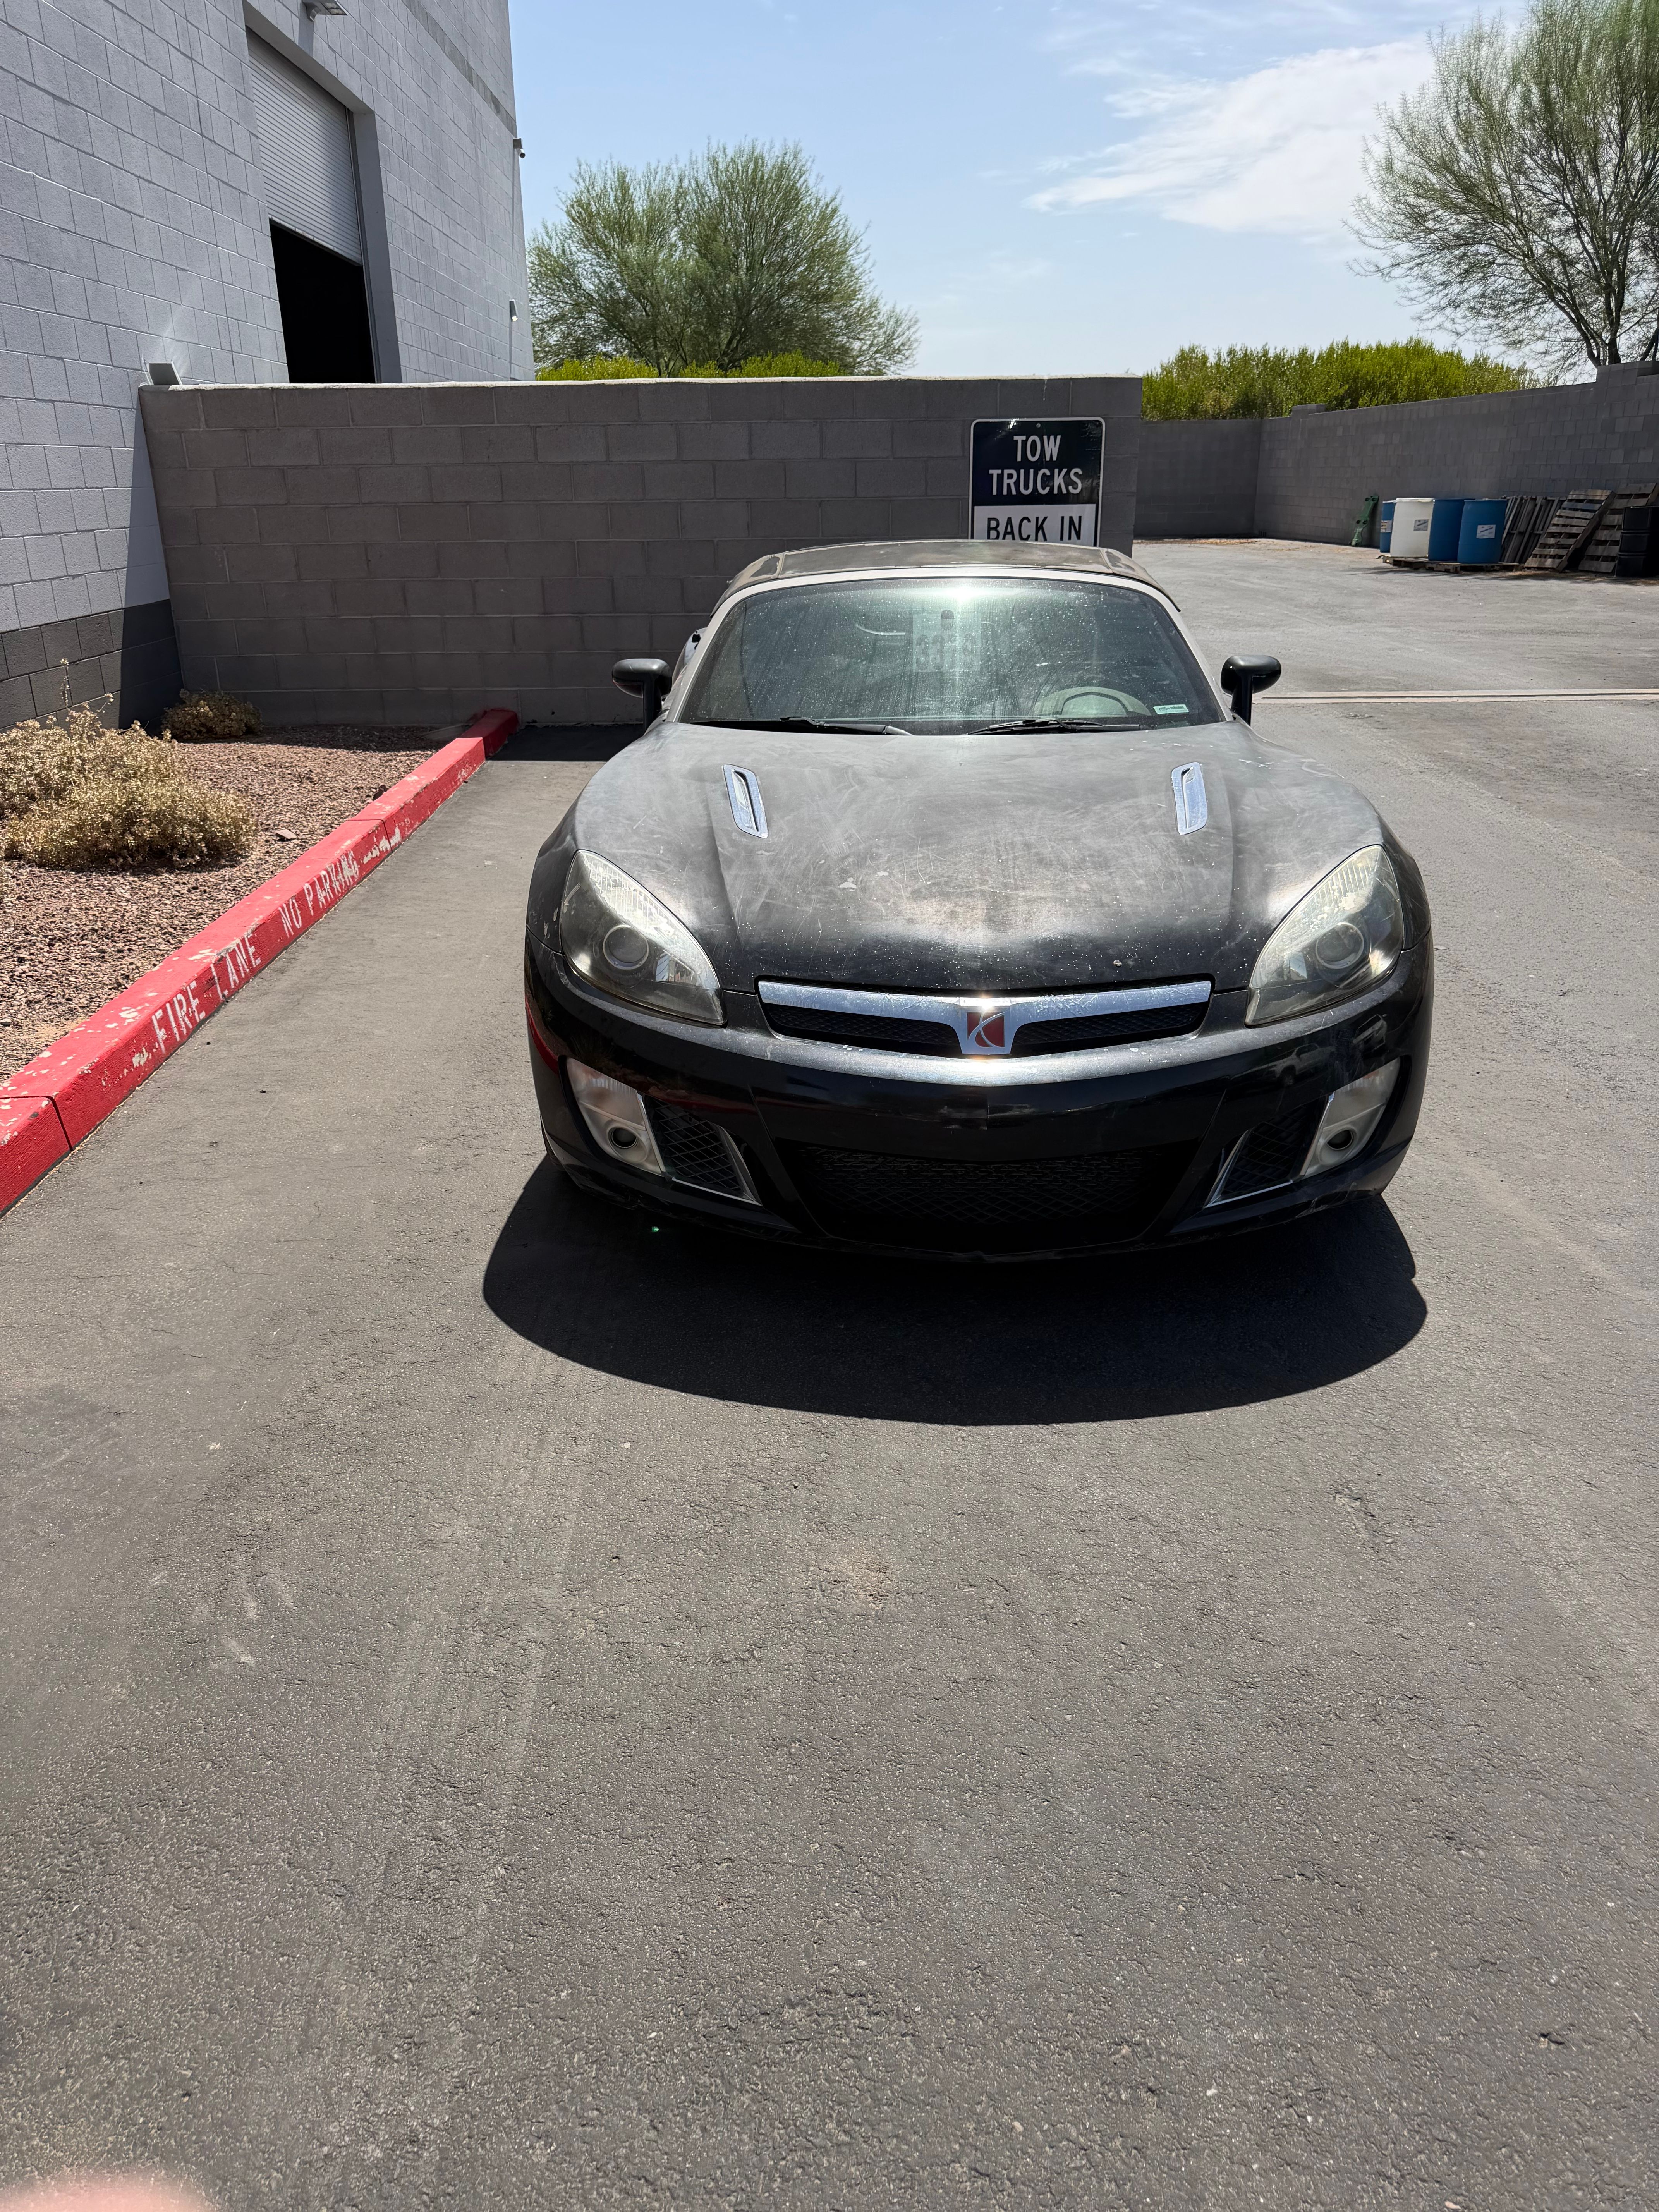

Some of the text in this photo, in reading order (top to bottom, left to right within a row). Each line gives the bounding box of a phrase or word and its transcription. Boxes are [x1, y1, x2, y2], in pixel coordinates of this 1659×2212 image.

[1013, 435, 1061, 462] TOW
[989, 468, 1082, 495] TRUCKS
[987, 516, 1082, 541] BACK IN
[151, 850, 359, 1054] FIRE LANE NO PARKING
